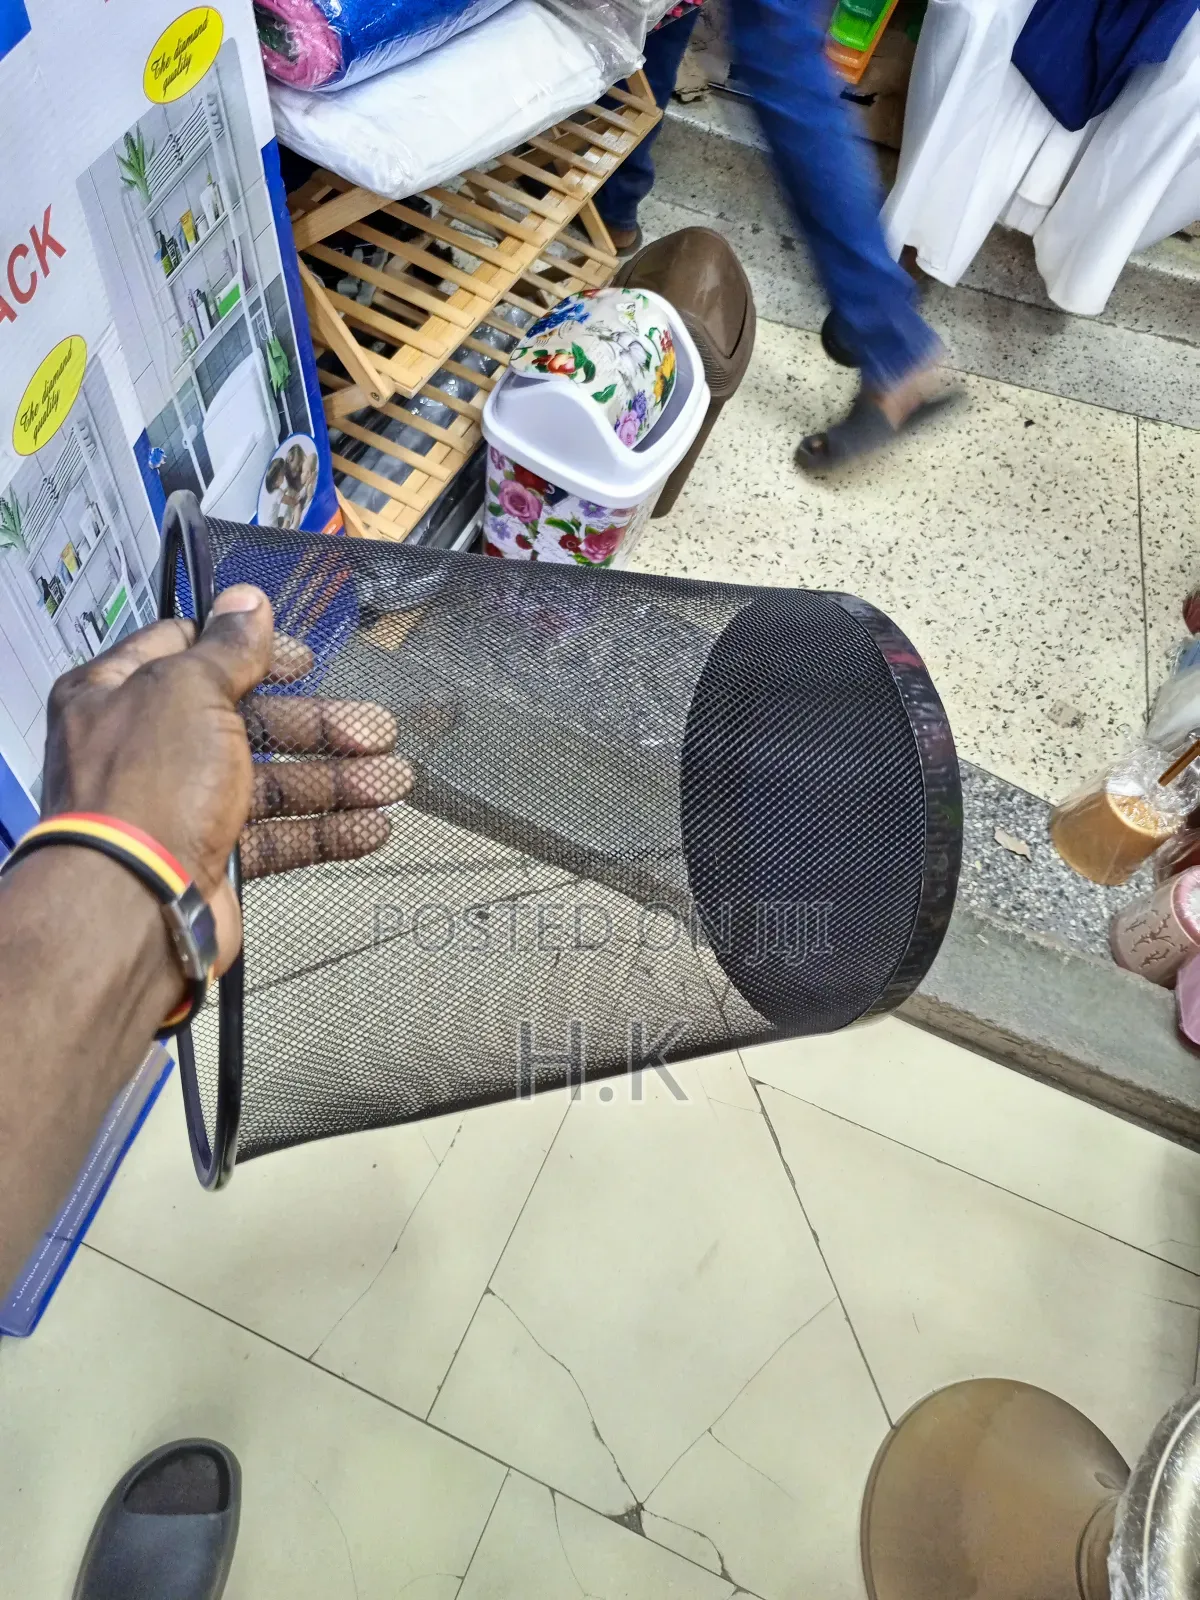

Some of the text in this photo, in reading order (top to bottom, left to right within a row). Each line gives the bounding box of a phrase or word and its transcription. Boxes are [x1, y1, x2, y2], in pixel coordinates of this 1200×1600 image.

[151, 9, 209, 80] The diamond
[163, 51, 193, 98] quality
[20, 339, 72, 433] The diamond
[33, 389, 60, 446] quality
